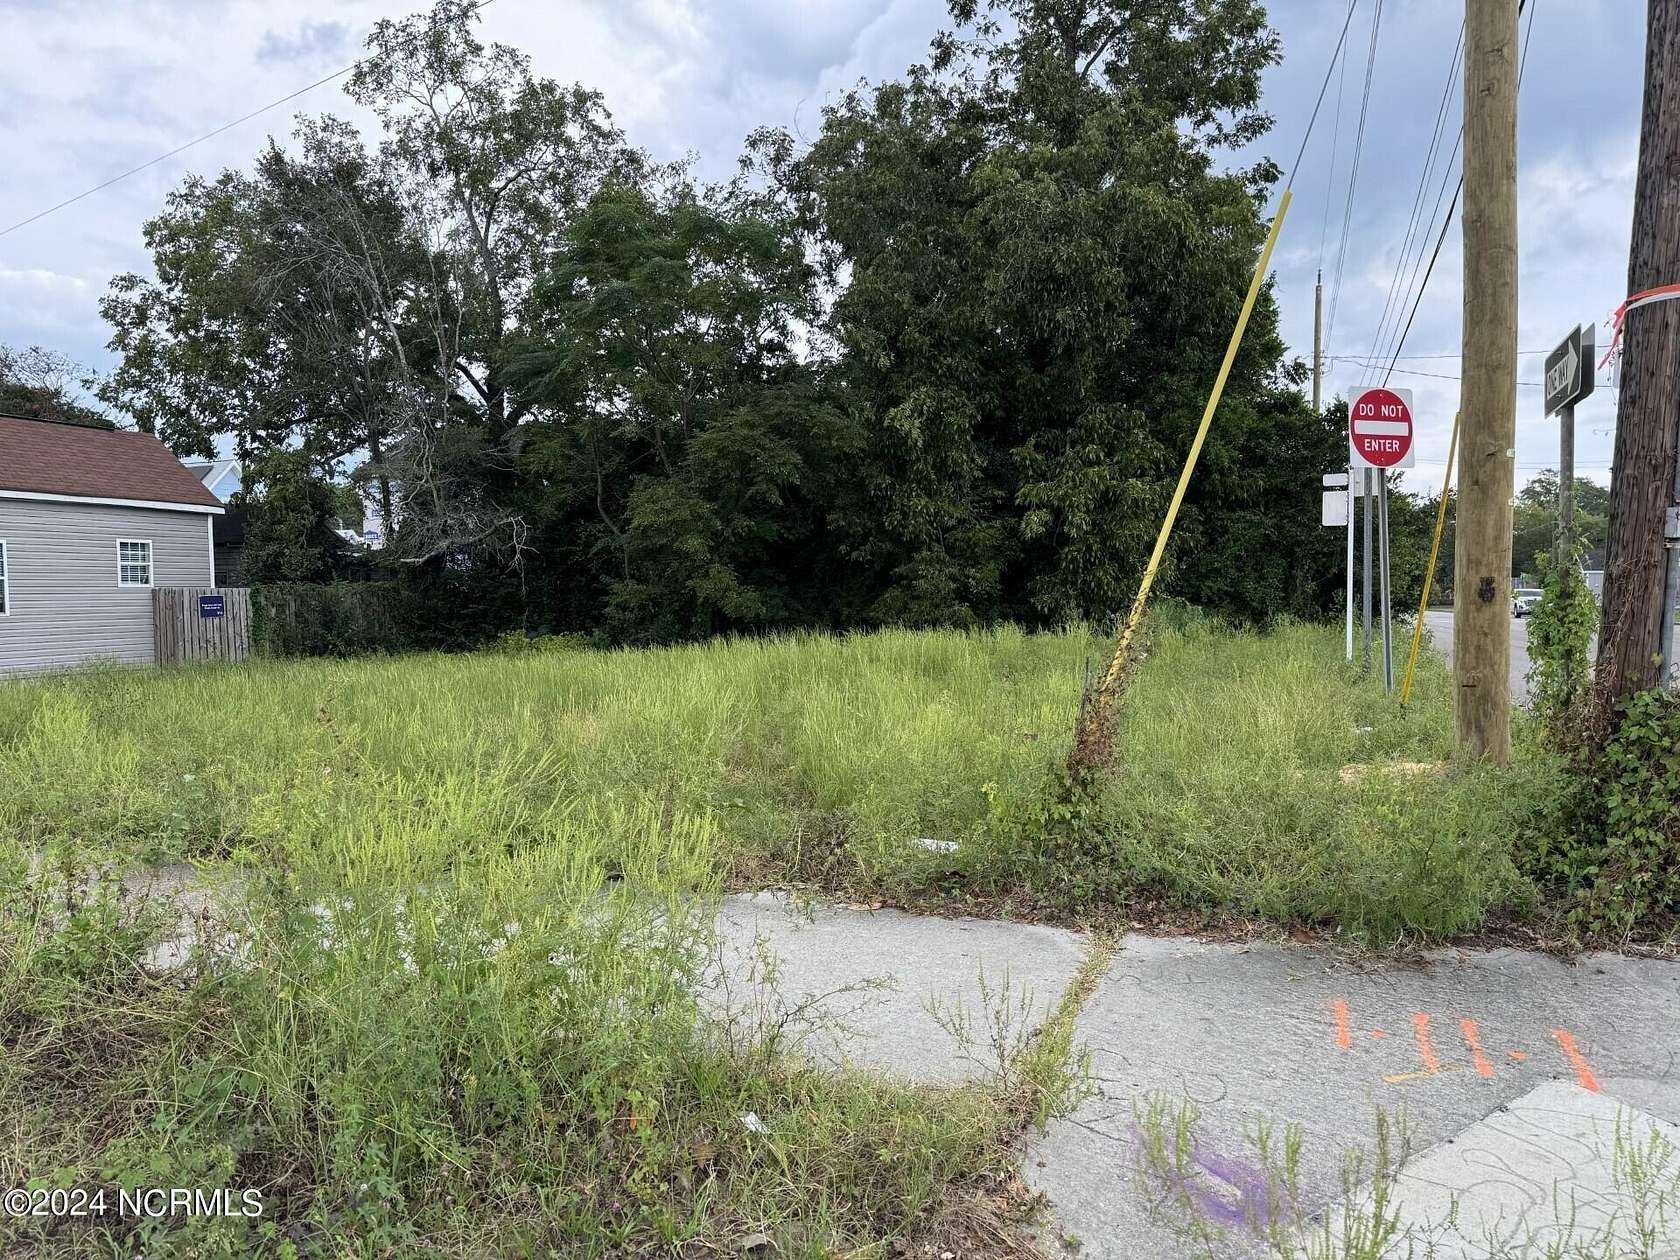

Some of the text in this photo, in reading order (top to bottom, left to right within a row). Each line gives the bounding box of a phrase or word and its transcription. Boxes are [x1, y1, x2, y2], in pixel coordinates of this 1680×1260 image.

[1548, 355, 1568, 398] ONE WAY
[1360, 404, 1403, 417] DO NOT
[1365, 439, 1400, 452] ENTER
